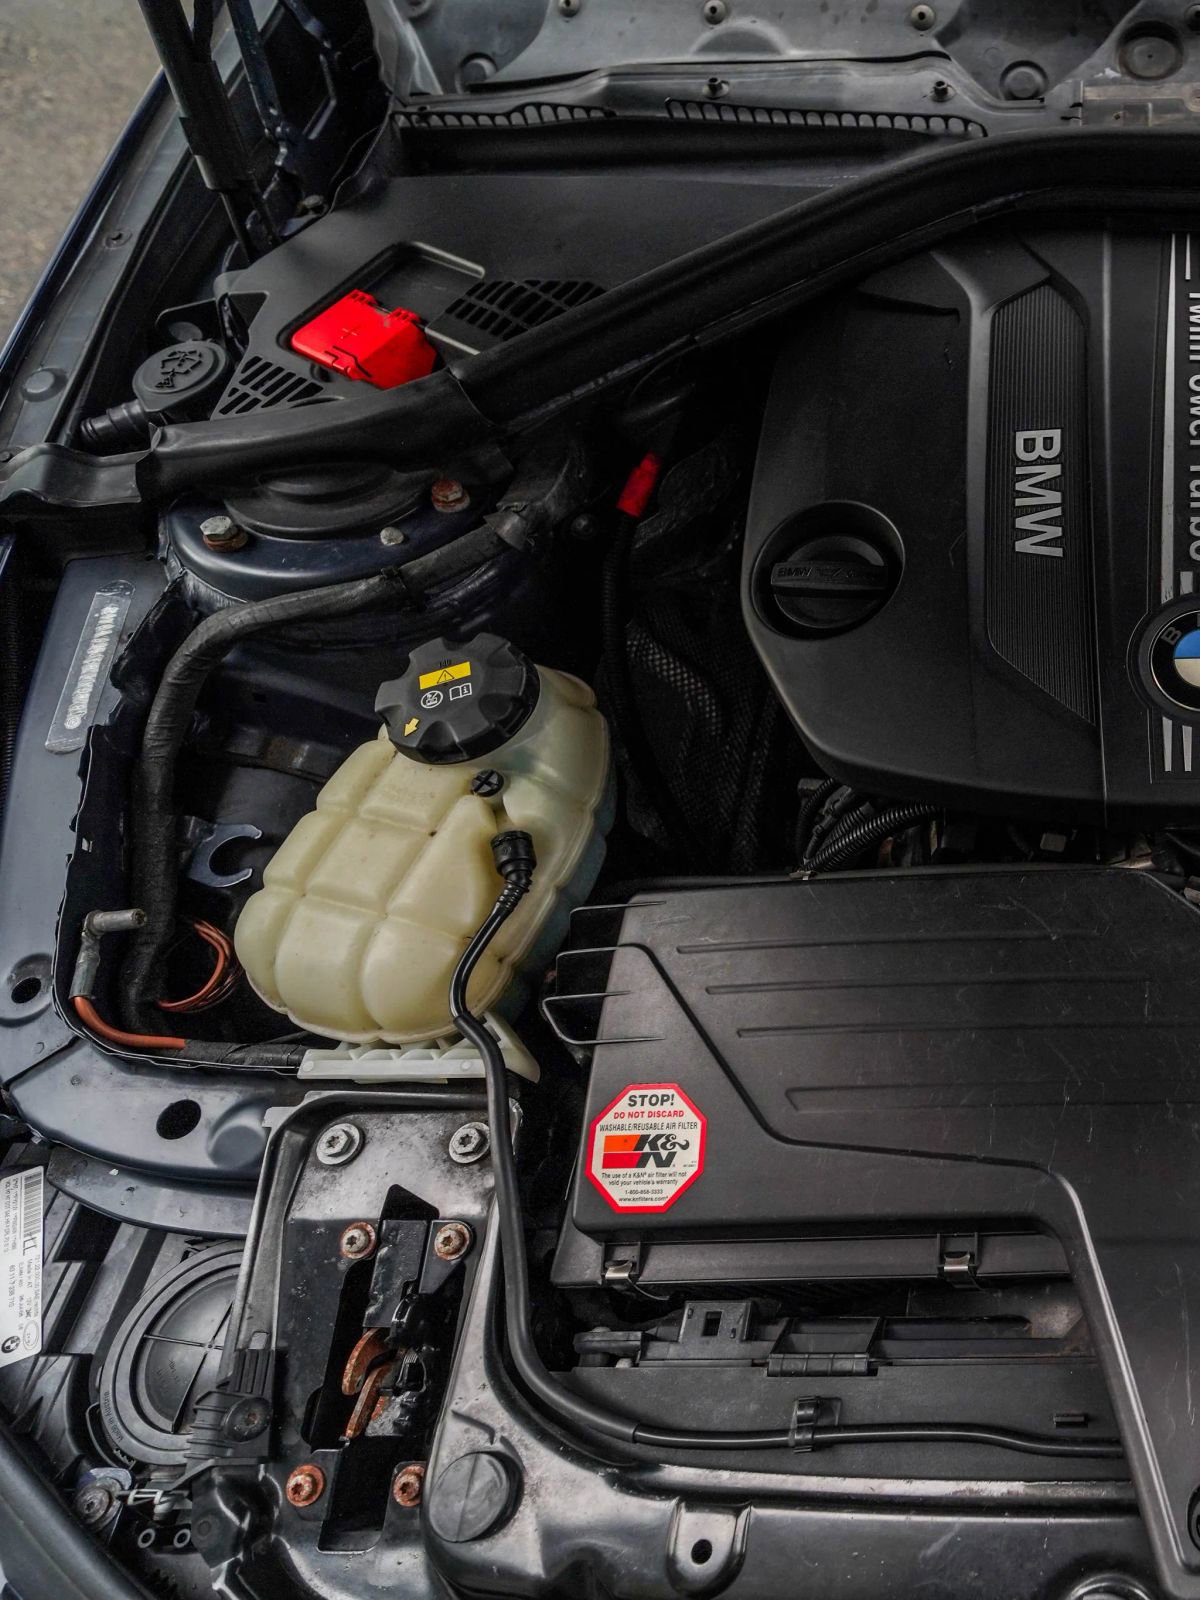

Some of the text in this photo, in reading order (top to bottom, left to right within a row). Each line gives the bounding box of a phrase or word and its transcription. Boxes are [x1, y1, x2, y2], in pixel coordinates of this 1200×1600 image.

[1014, 428, 1064, 558] BMW
[627, 1093, 675, 1107] STOP!
[613, 1109, 685, 1120] DO NOT DISCARD
[599, 1121, 698, 1132] WASHABLE/REUSABLE AIR FILTER
[656, 1178, 679, 1186] warranty
